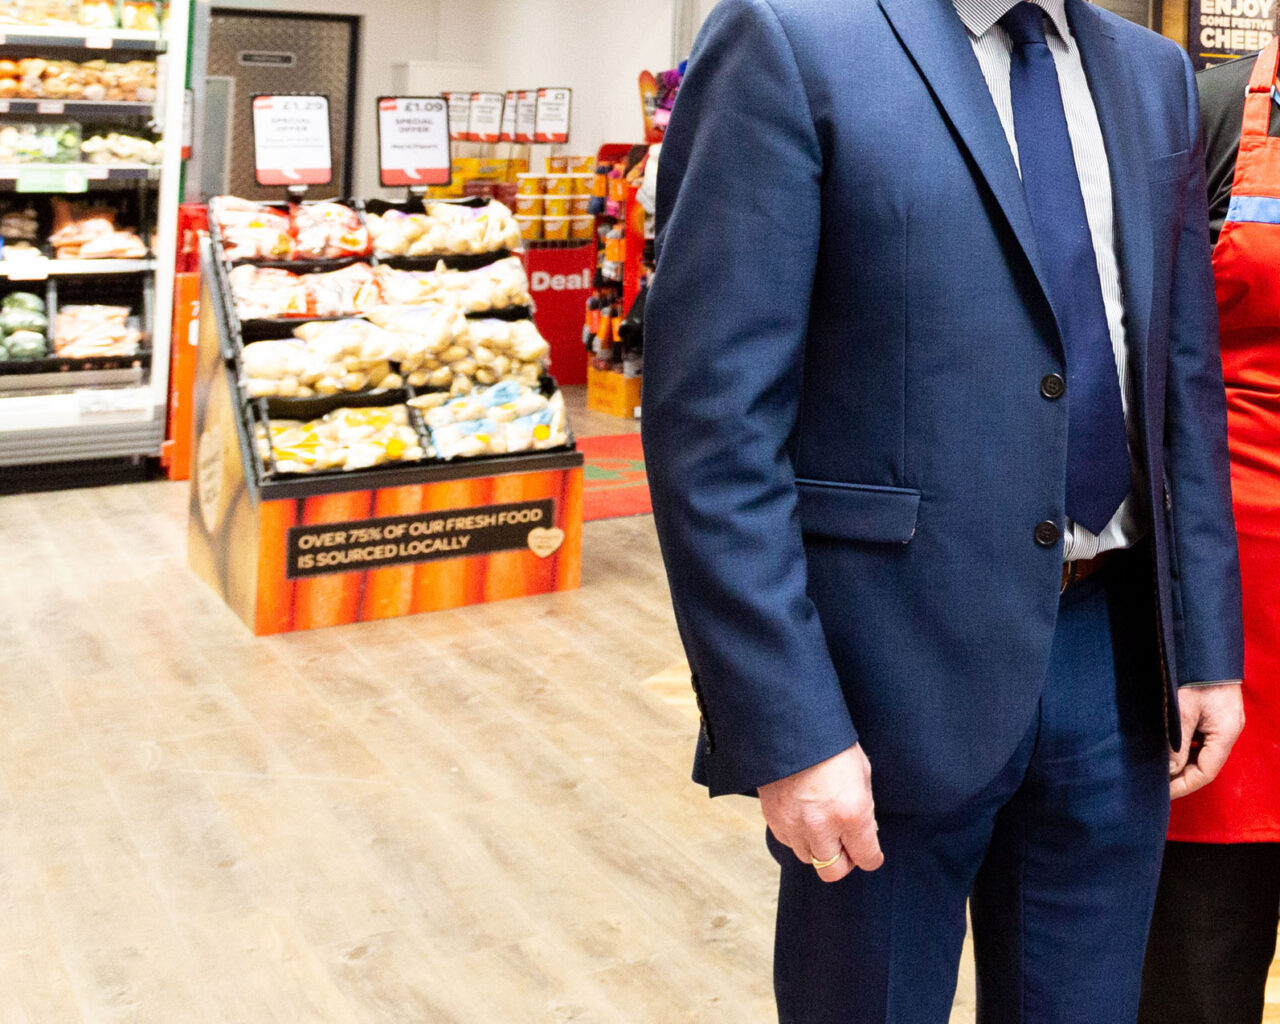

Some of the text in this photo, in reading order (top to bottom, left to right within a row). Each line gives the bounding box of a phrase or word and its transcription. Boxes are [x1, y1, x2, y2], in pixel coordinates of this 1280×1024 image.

[1200, 14, 1273, 31] SOME FESTIVE
[404, 102, 443, 112] £1.09
[530, 268, 592, 291] Deal
[298, 508, 544, 550] OVER 75% OF OUR FRESH FOOD
[297, 534, 473, 570] IS SOURCED LOCALLY
